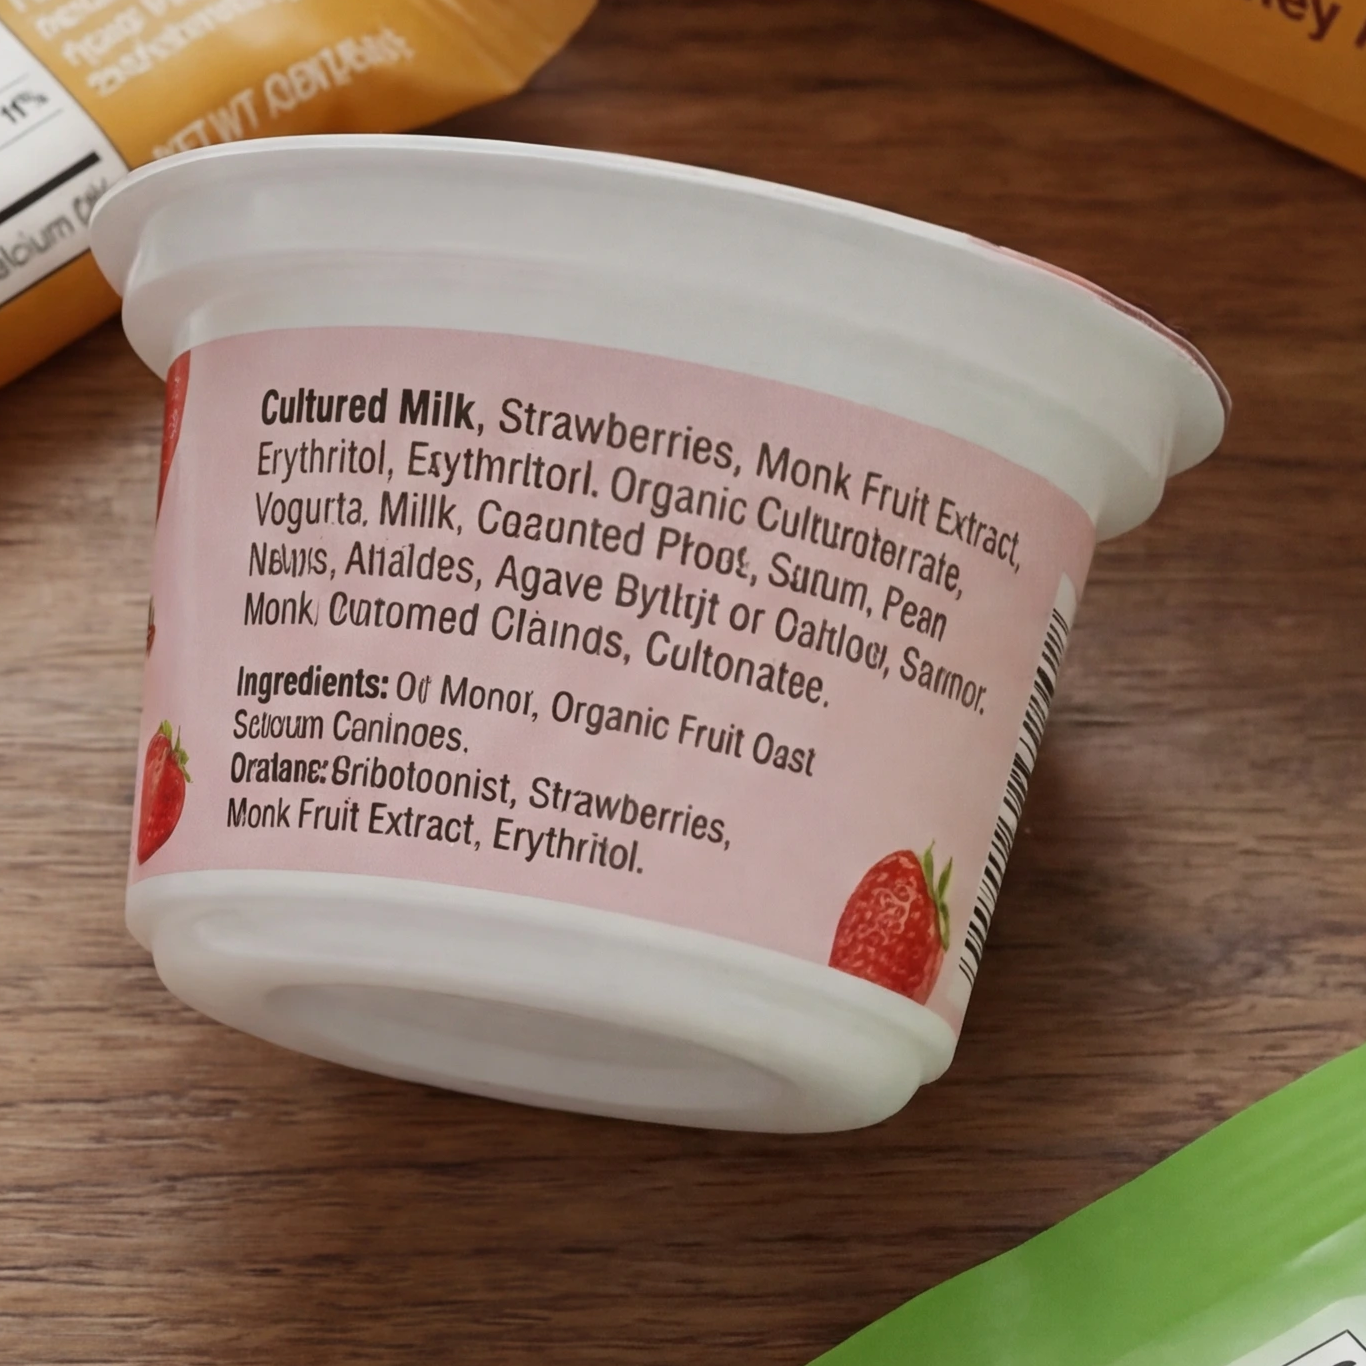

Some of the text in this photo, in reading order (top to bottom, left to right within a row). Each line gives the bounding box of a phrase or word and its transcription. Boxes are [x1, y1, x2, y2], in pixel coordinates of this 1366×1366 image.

[257, 437, 748, 527] Erythritol, Organic
[260, 386, 1021, 575] Cultured Milk, Strawberries, Monk Fruit Extract,
[494, 554, 767, 635] Agave or
[881, 584, 948, 643] Pean
[645, 629, 829, 709] Cultonatee.
[236, 663, 746, 759] Ingredients: Organic Fruit
[226, 796, 644, 875] Monk Fruit Extract, Erythritol.
[528, 776, 731, 852] Strawberries,
